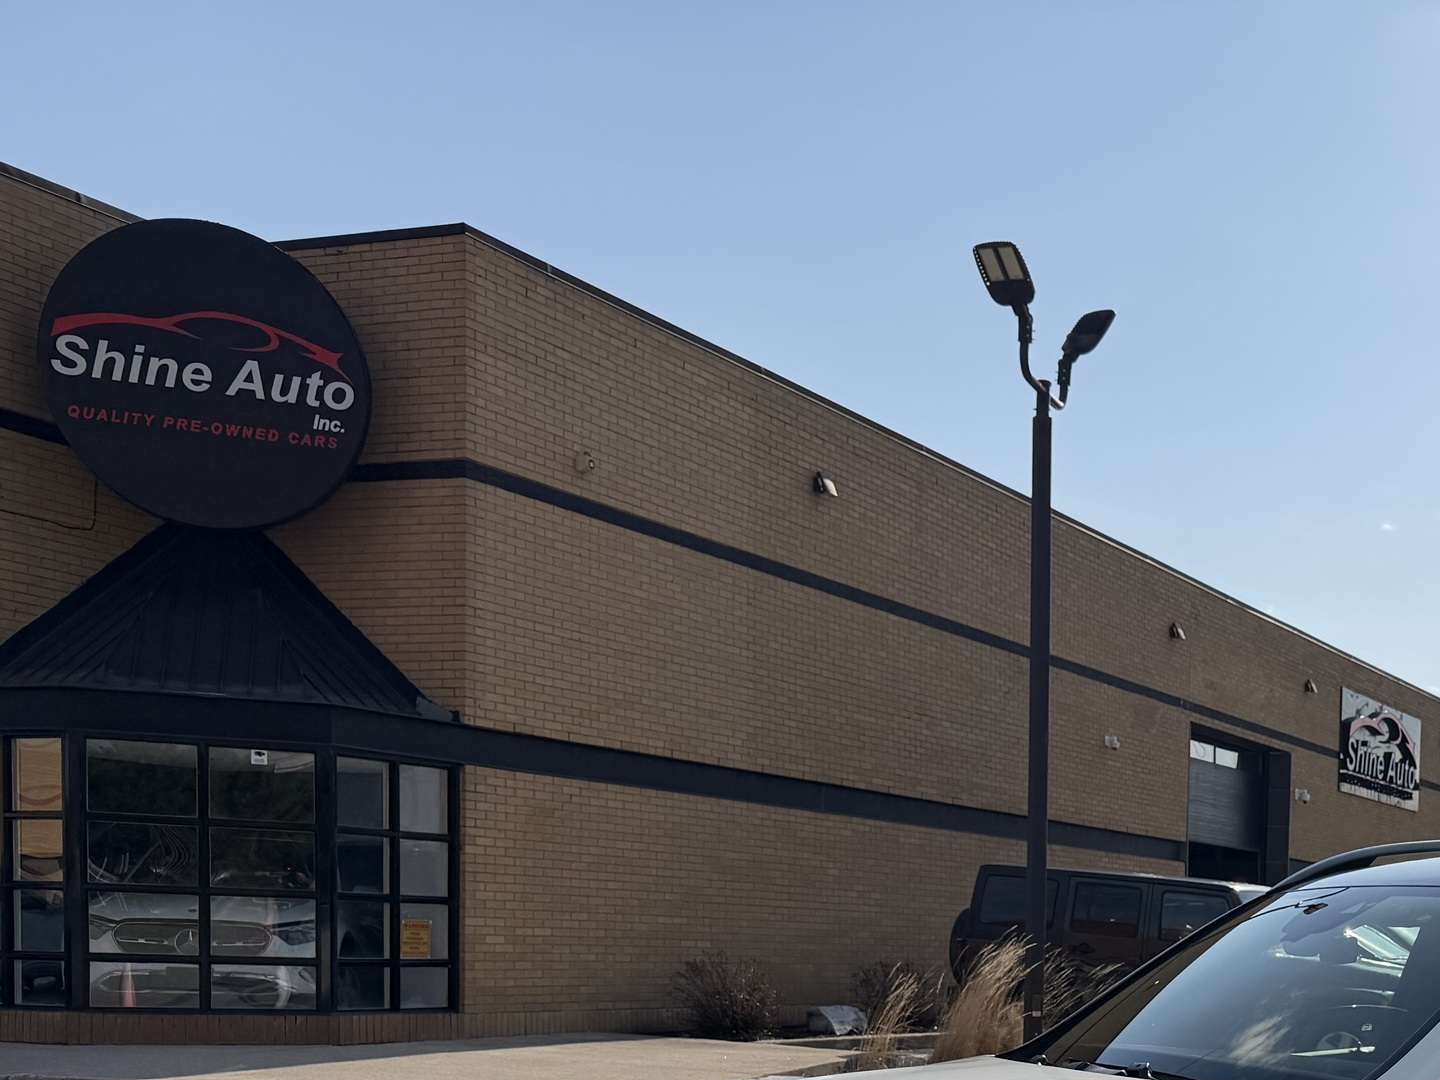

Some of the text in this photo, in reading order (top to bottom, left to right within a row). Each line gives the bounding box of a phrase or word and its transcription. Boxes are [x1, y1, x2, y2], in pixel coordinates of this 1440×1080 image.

[51, 334, 355, 411] Shine Auto
[67, 404, 338, 450] QUALITY PRE-OWNED CARS
[312, 414, 345, 434] Inc.
[1346, 739, 1385, 780] Shine
[1386, 752, 1416, 790] Auto
